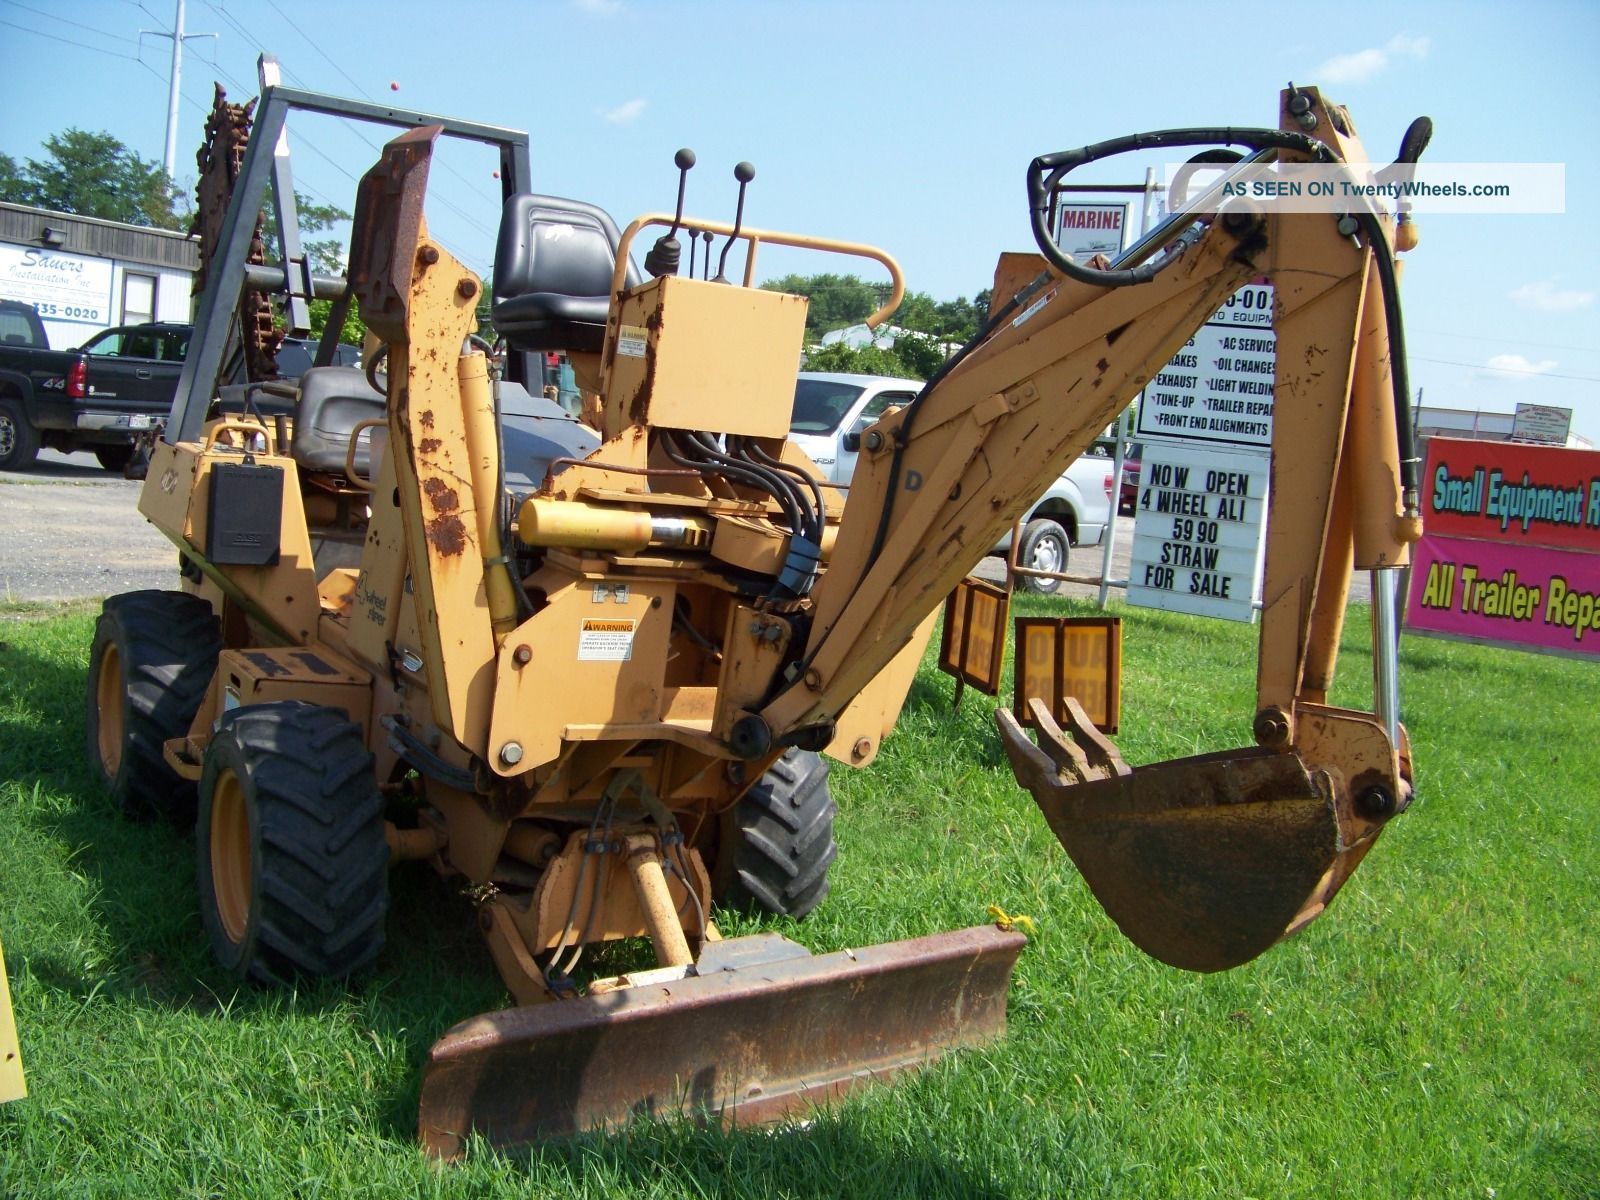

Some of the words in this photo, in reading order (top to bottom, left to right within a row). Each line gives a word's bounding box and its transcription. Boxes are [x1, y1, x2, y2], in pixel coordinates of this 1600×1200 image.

[1062, 210, 1121, 230] MARINE
[20, 248, 84, 273] Sauers
[1233, 312, 1274, 325] EQUIPM
[1223, 337, 1236, 351] AC
[1217, 357, 1232, 372] OIL
[1156, 373, 1199, 389] EXHAUST
[1210, 380, 1237, 394] LIGHT
[1239, 381, 1274, 396] WELDIN
[1156, 393, 1196, 409] TUNE-UP
[1208, 398, 1244, 414] TRAILER
[1158, 413, 1189, 428] FRONT
[1189, 416, 1208, 430] END
[1209, 418, 1269, 437] ALIGNMENTS
[905, 469, 923, 491] D
[1150, 463, 1191, 489] NOW
[1206, 470, 1250, 496] OPEN
[1141, 488, 1152, 509] 4
[1157, 490, 1208, 517] WHEEL
[1217, 498, 1246, 521] ALI
[1433, 465, 1485, 513] Small
[1486, 470, 1584, 532] Equipment
[1161, 542, 1219, 570] STRAW
[1145, 565, 1175, 589] FOR
[1190, 572, 1232, 598] SALE
[1421, 561, 1455, 609] All
[1460, 564, 1541, 621] Trailer
[592, 624, 633, 632] WARNING
